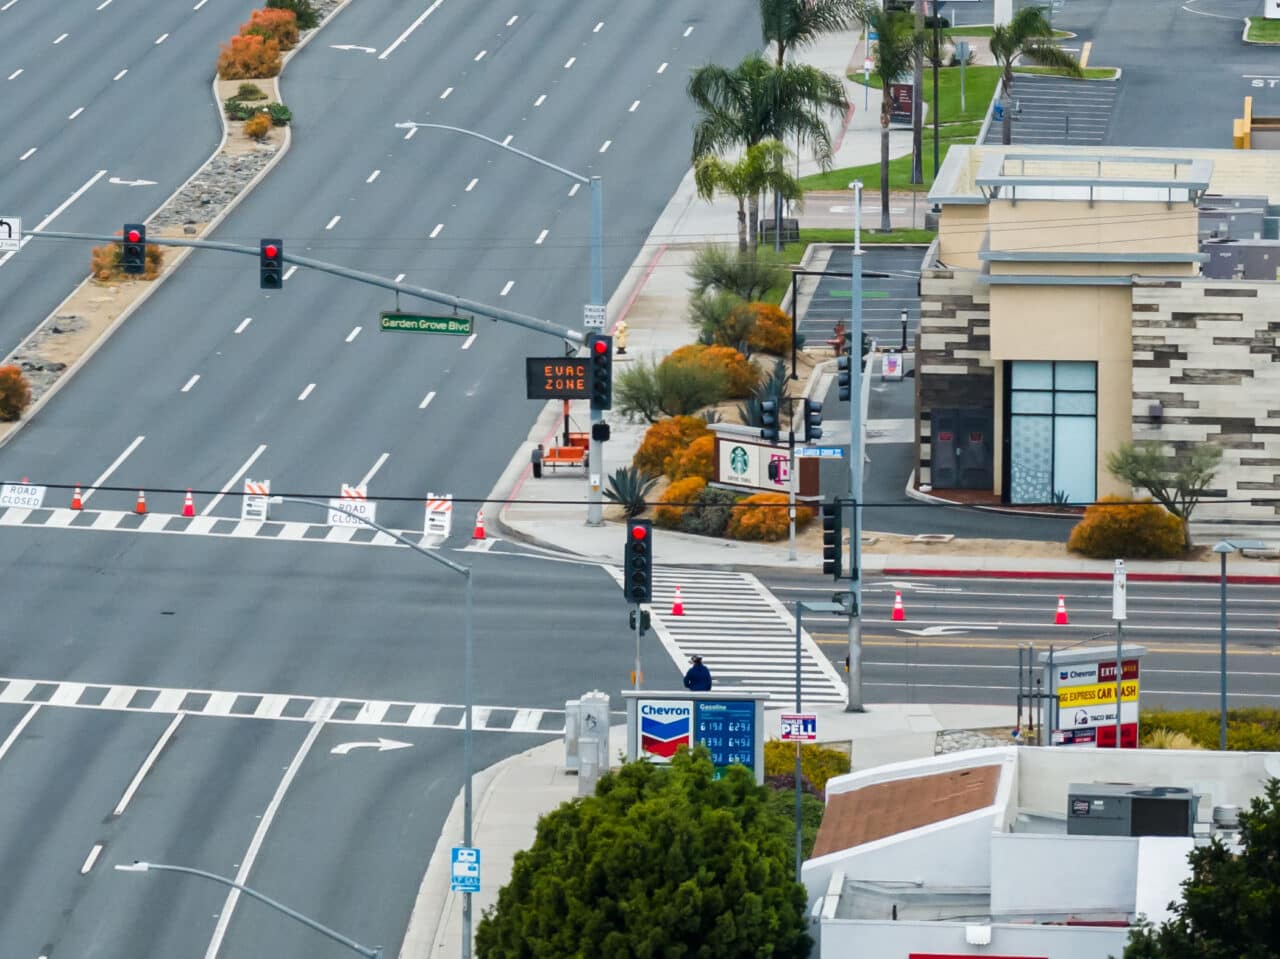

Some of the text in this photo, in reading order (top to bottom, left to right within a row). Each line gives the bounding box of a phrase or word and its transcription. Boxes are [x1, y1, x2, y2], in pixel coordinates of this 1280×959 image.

[382, 318, 470, 331] Garden Grove Blvd
[544, 365, 584, 376] EVAC
[544, 379, 584, 389] ZONE
[10, 486, 38, 496] ROAD
[1, 495, 40, 506] CLOSED
[338, 503, 366, 514] ROAD
[1070, 670, 1097, 679] Chevron
[1097, 687, 1112, 699] CAR
[641, 705, 690, 716] Chevron
[781, 724, 816, 736] PELL
